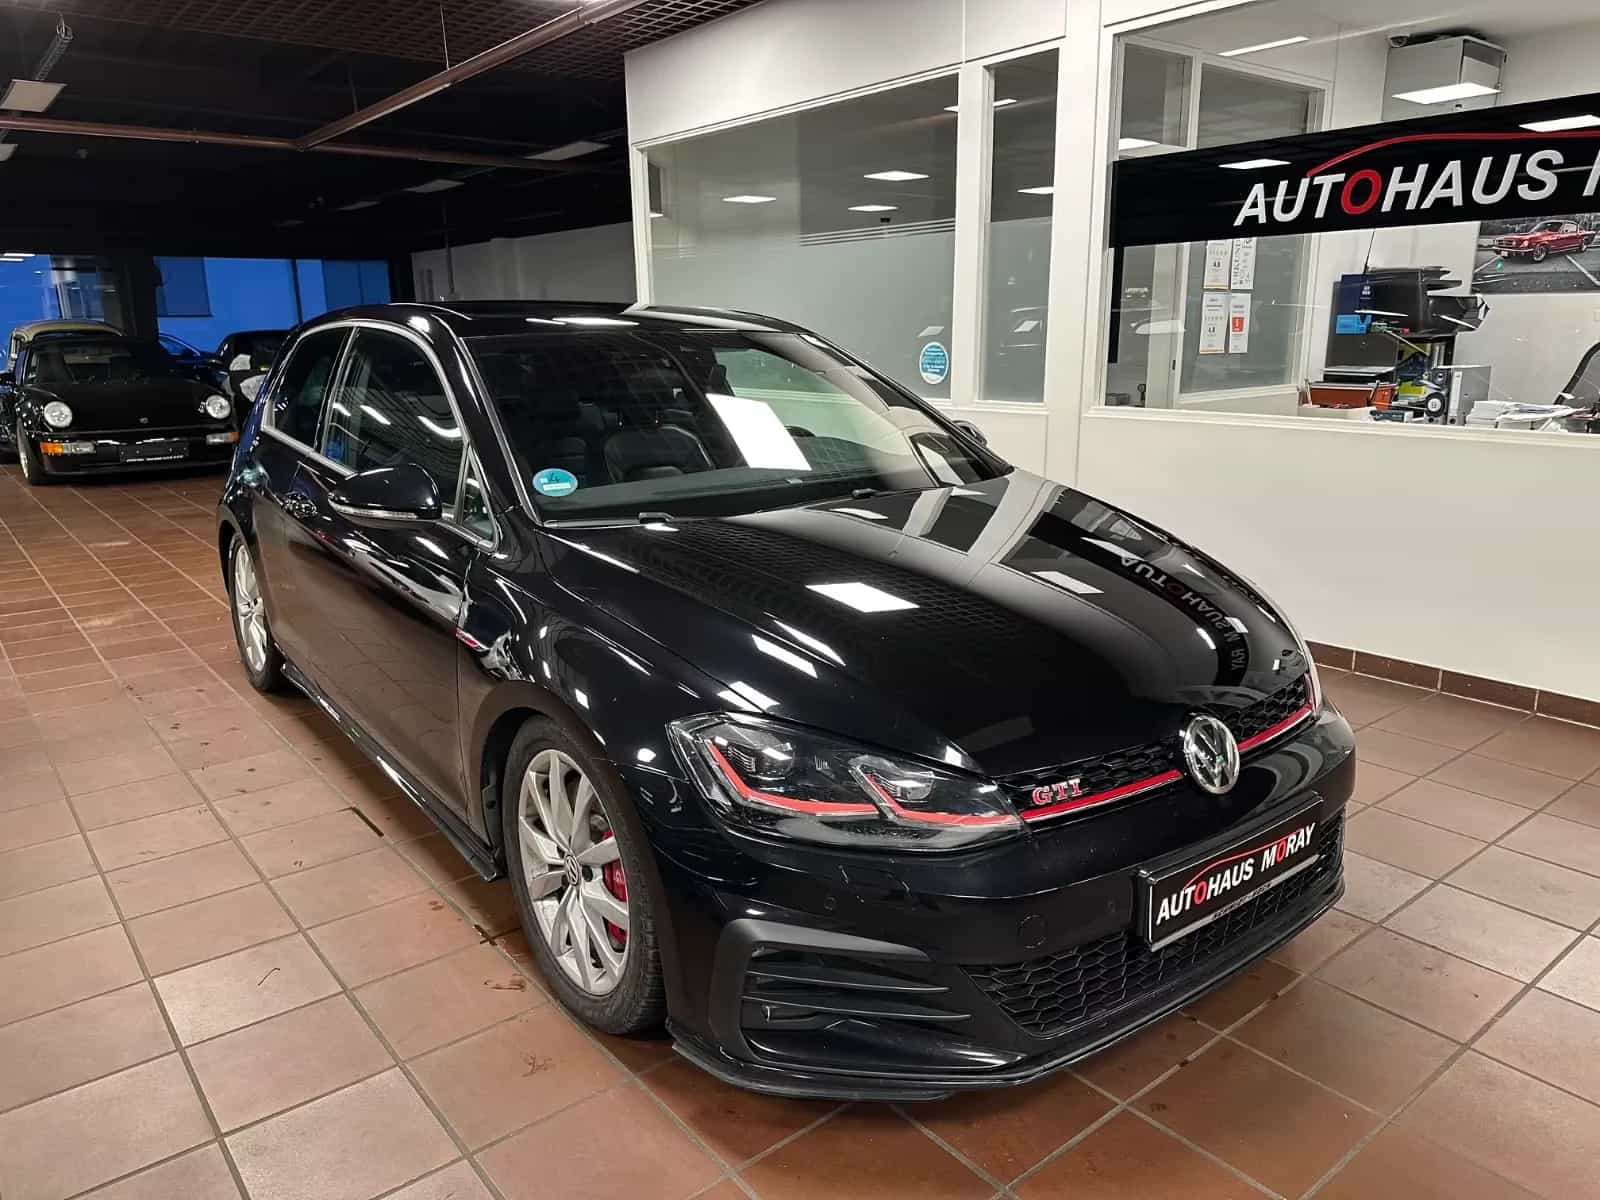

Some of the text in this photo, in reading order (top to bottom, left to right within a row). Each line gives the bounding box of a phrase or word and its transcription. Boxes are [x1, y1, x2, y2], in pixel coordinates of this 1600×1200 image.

[1233, 149, 1564, 227] AUTOHAUS
[1032, 778, 1082, 805] GTI
[1156, 858, 1255, 926] AUTOHAUS
[1261, 822, 1316, 872] MORAY
